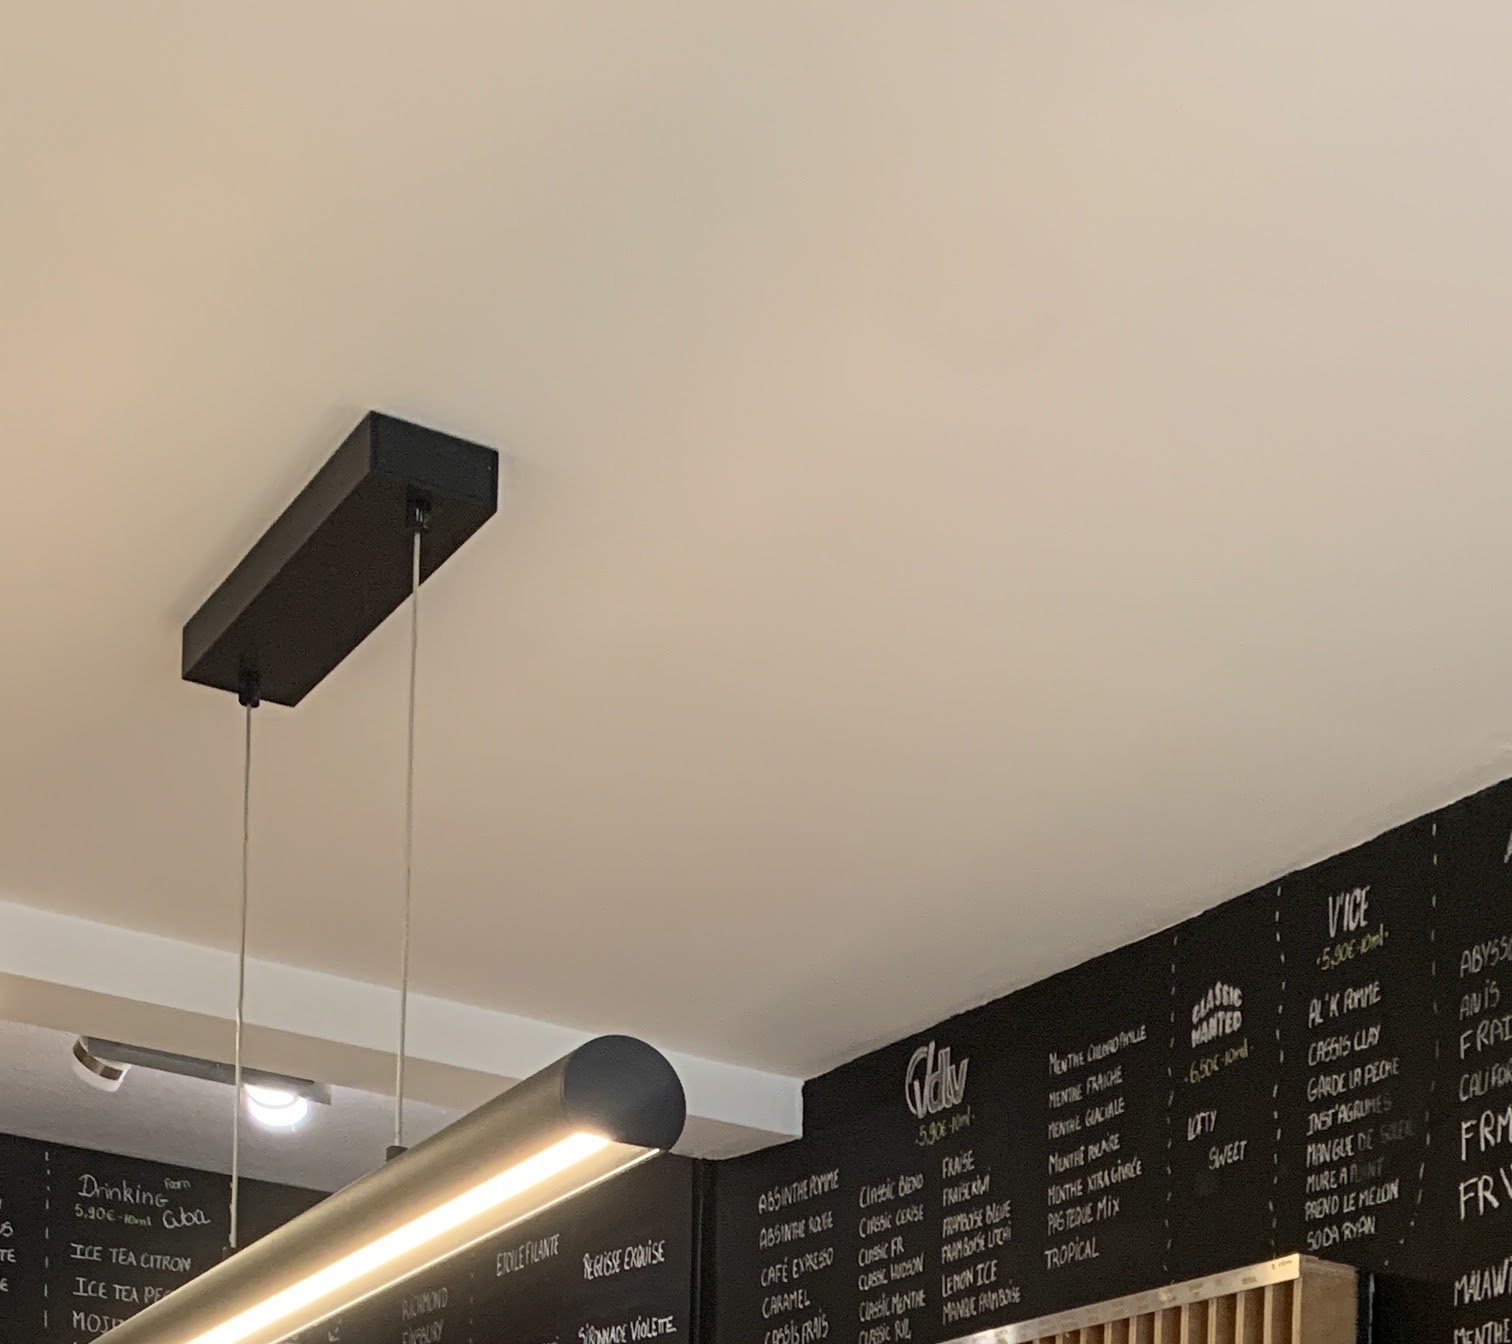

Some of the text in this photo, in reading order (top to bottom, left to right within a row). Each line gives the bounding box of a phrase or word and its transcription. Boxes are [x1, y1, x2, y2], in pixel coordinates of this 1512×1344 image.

[70, 1242, 191, 1272] ICE TEA CITRON
[1044, 1236, 1100, 1270] TROPICAL
